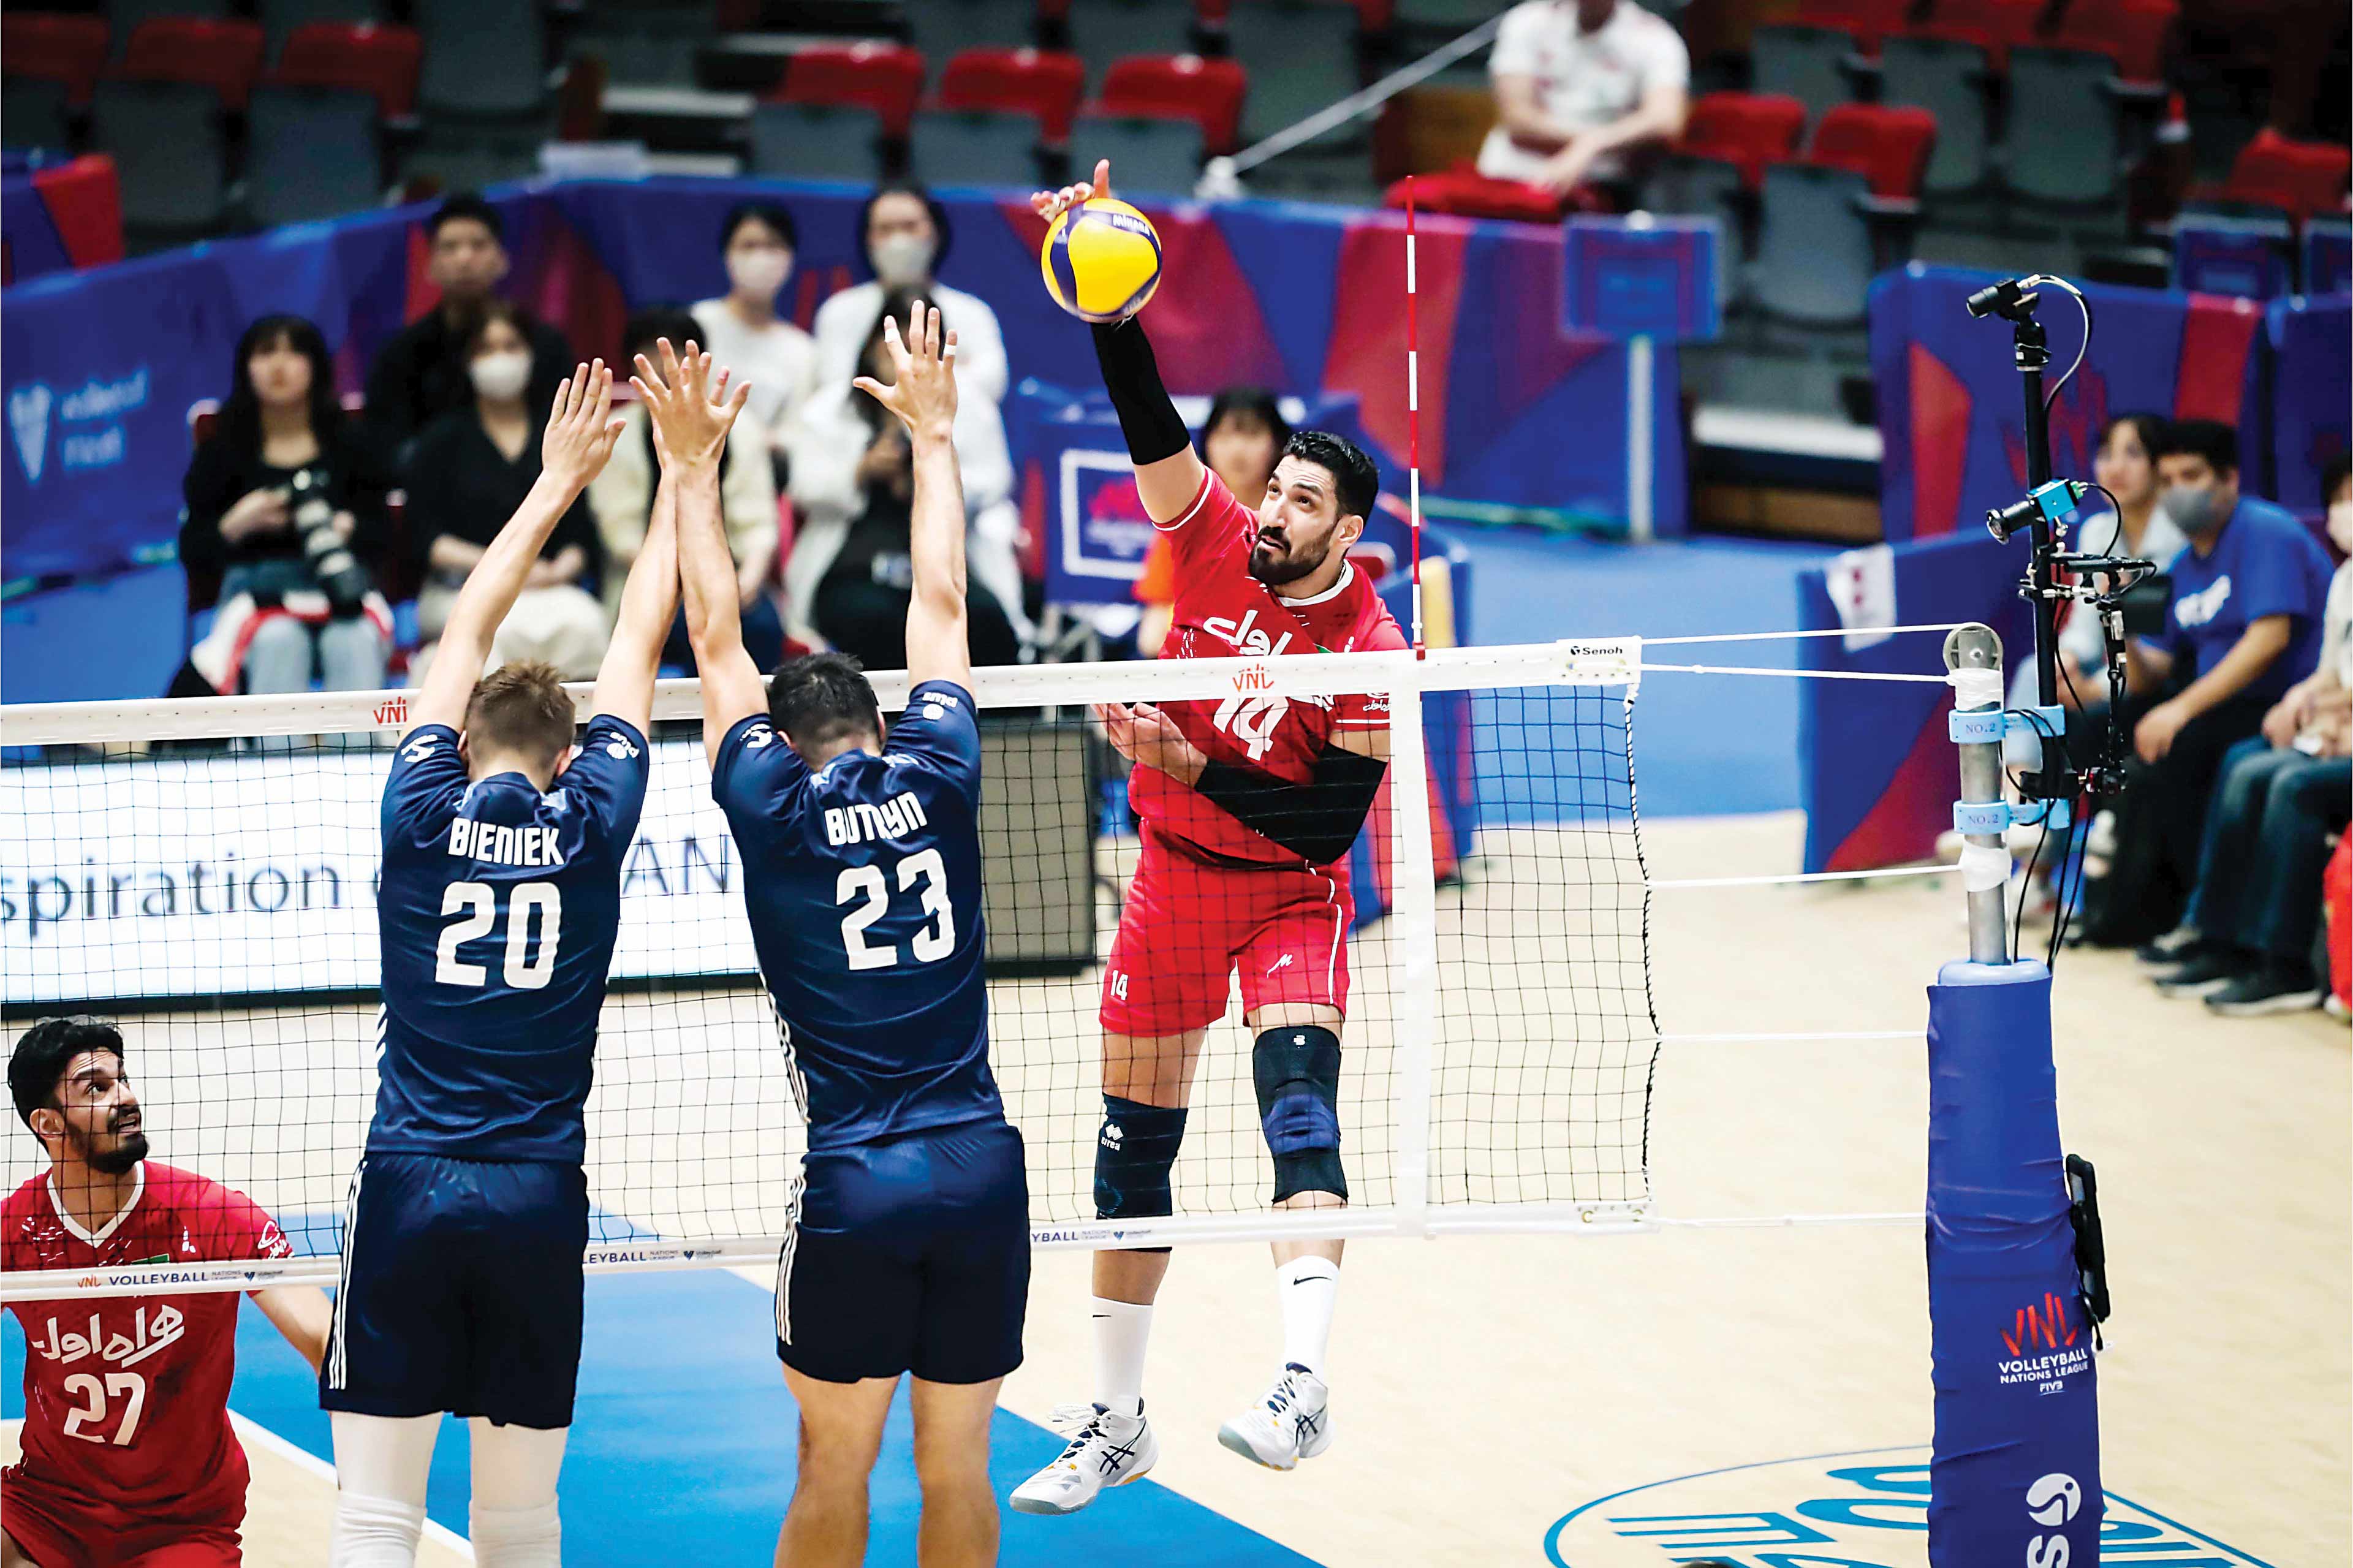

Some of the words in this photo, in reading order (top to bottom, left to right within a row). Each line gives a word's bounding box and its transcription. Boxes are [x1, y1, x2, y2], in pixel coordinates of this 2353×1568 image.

[1582, 646, 1623, 655] Senoh
[1233, 664, 1275, 692] VNL
[1966, 723, 1996, 733] NO.2
[825, 792, 927, 846] BUTRYN
[1969, 814, 1999, 825] NO.2
[448, 817, 564, 866] BIENIEK
[836, 848, 955, 971] 23
[435, 881, 562, 989] 20
[1110, 969, 1128, 1001] 14
[78, 1274, 102, 1288] VNL
[109, 1272, 208, 1286] VOLLEYBALL
[2000, 1292, 2079, 1357] VNL
[1998, 1347, 2088, 1374] VOLLEYBALL
[2000, 1370, 2052, 1384] NATIONS
[2055, 1361, 2088, 1377] LEAGUE
[63, 1372, 146, 1445] 27
